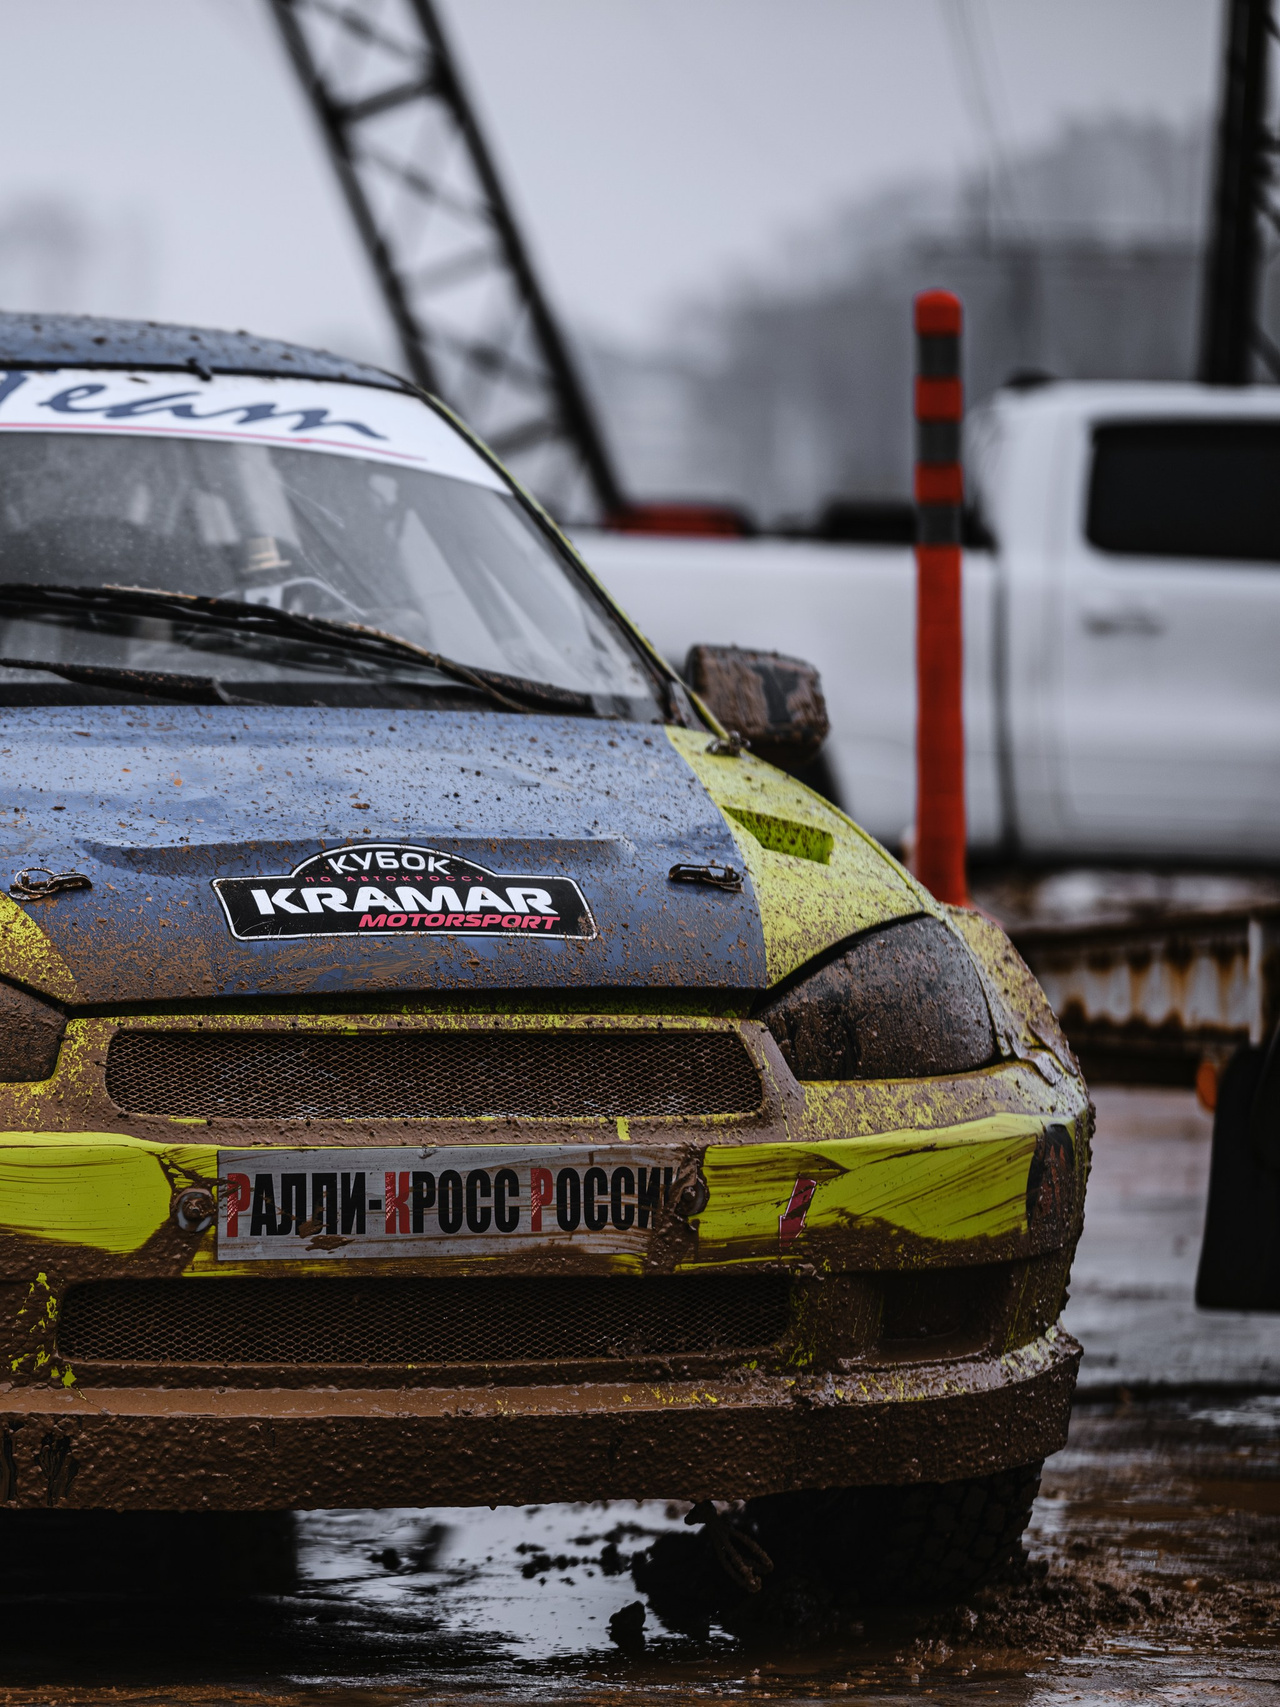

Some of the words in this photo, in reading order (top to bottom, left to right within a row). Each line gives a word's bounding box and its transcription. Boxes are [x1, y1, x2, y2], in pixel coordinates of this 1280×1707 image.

[328, 851, 451, 875] КУБОК
[251, 885, 559, 915] KRAMAR
[358, 913, 561, 930] MOTORSPORT
